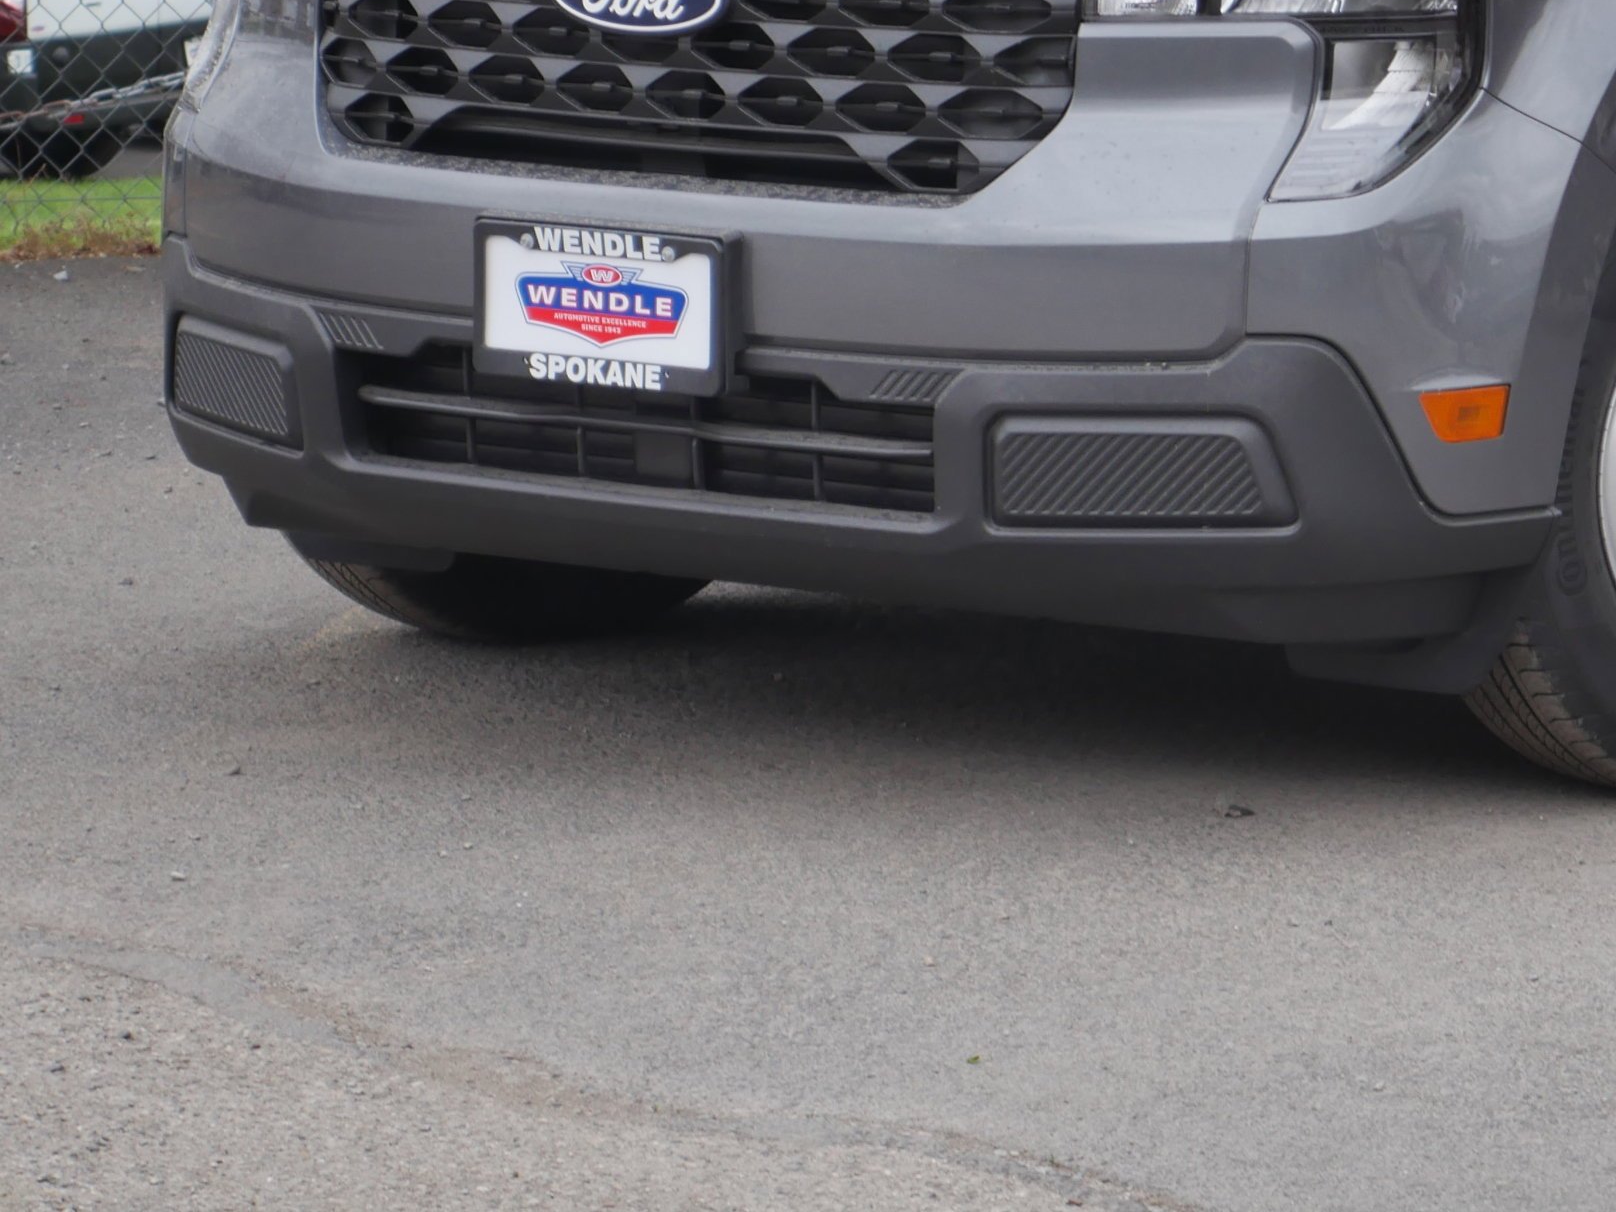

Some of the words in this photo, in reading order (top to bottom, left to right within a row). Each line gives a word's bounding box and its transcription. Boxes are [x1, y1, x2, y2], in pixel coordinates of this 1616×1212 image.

[533, 226, 662, 261] WENDLE
[527, 284, 672, 317] WENDLE
[553, 313, 600, 323] AUTOMOTIVE
[601, 317, 647, 328] EXCELLENCE
[581, 324, 602, 332] SINCE
[604, 326, 621, 334] 1943
[529, 352, 661, 390] SPOKANE
